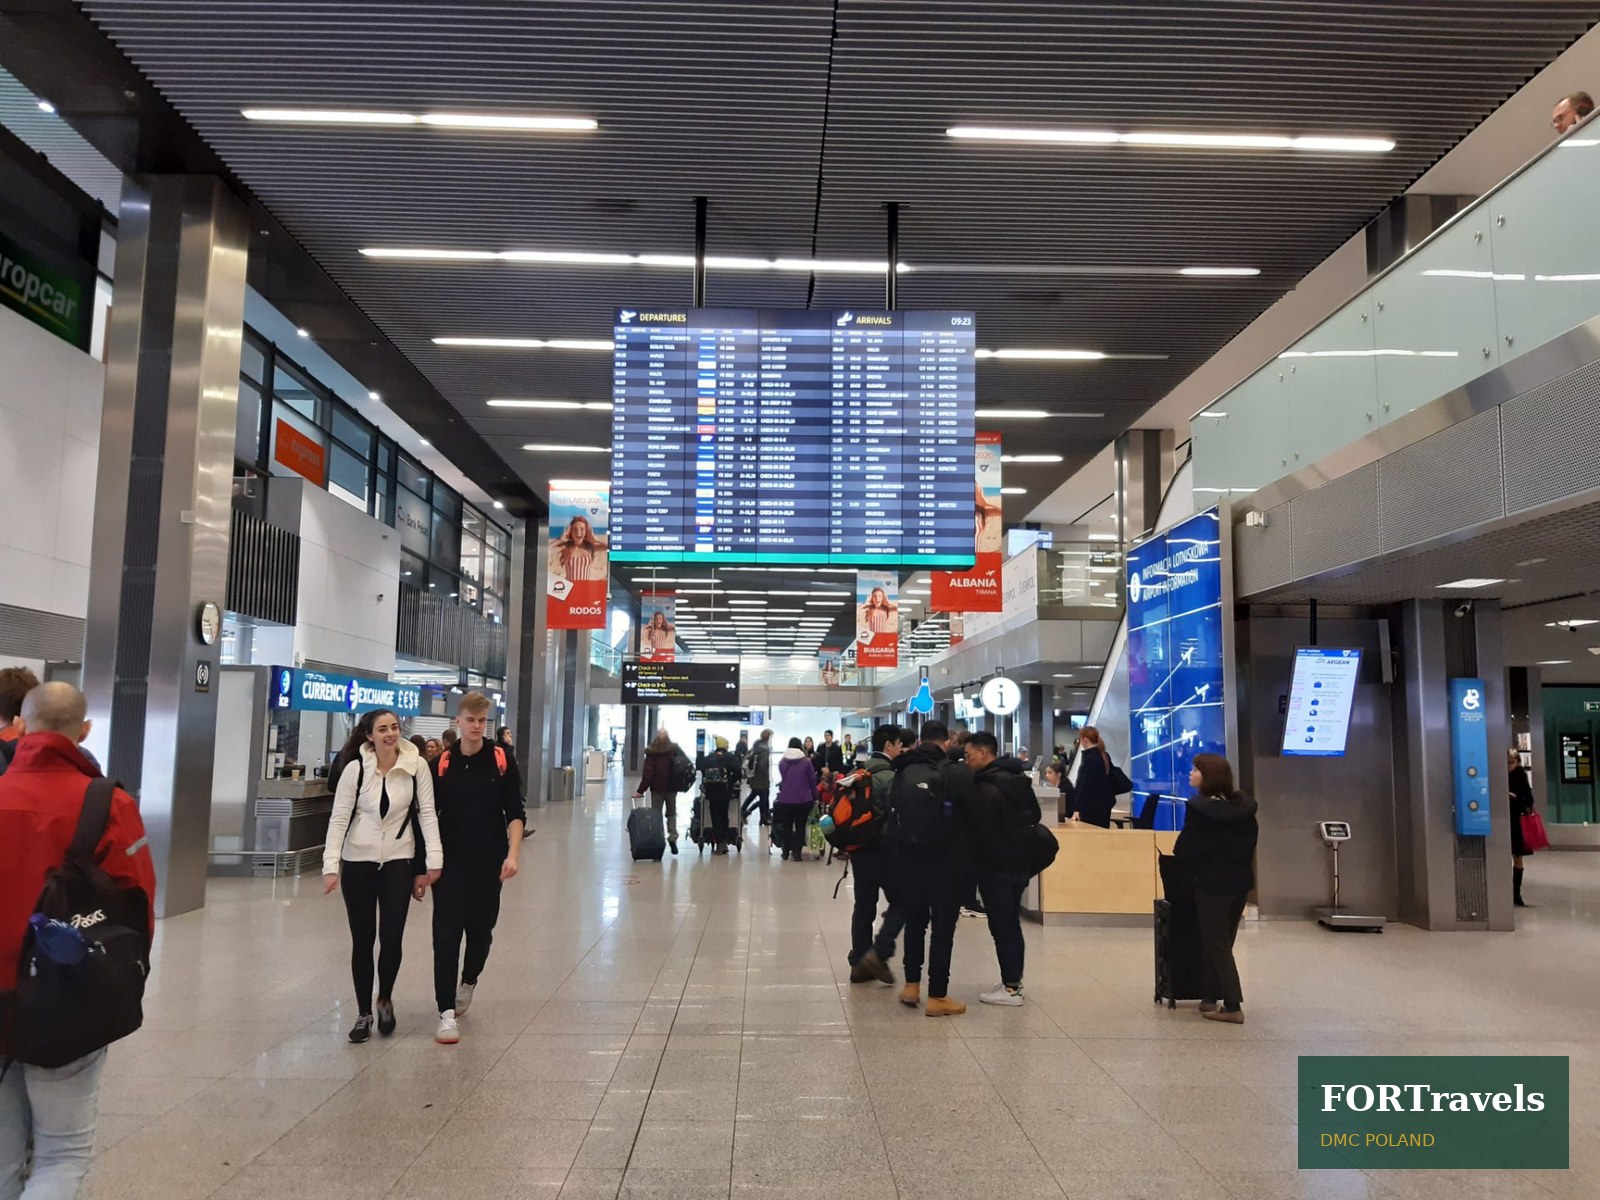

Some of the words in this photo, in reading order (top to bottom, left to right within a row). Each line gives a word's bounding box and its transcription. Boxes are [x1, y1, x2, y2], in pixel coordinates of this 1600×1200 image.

[0, 254, 77, 318] ropcar
[640, 313, 686, 322] DEPARTURES
[856, 317, 892, 325] ARRIVALS
[951, 317, 972, 326] 09:23
[1142, 557, 1172, 581] INFORMACJA
[1173, 540, 1209, 568] LOTNISKOWA
[949, 578, 997, 588] ALBANIA
[570, 606, 602, 616] RODOS
[302, 680, 347, 702] CURRENCY
[358, 686, 394, 706] EXCHANGE
[278, 693, 289, 707] ice
